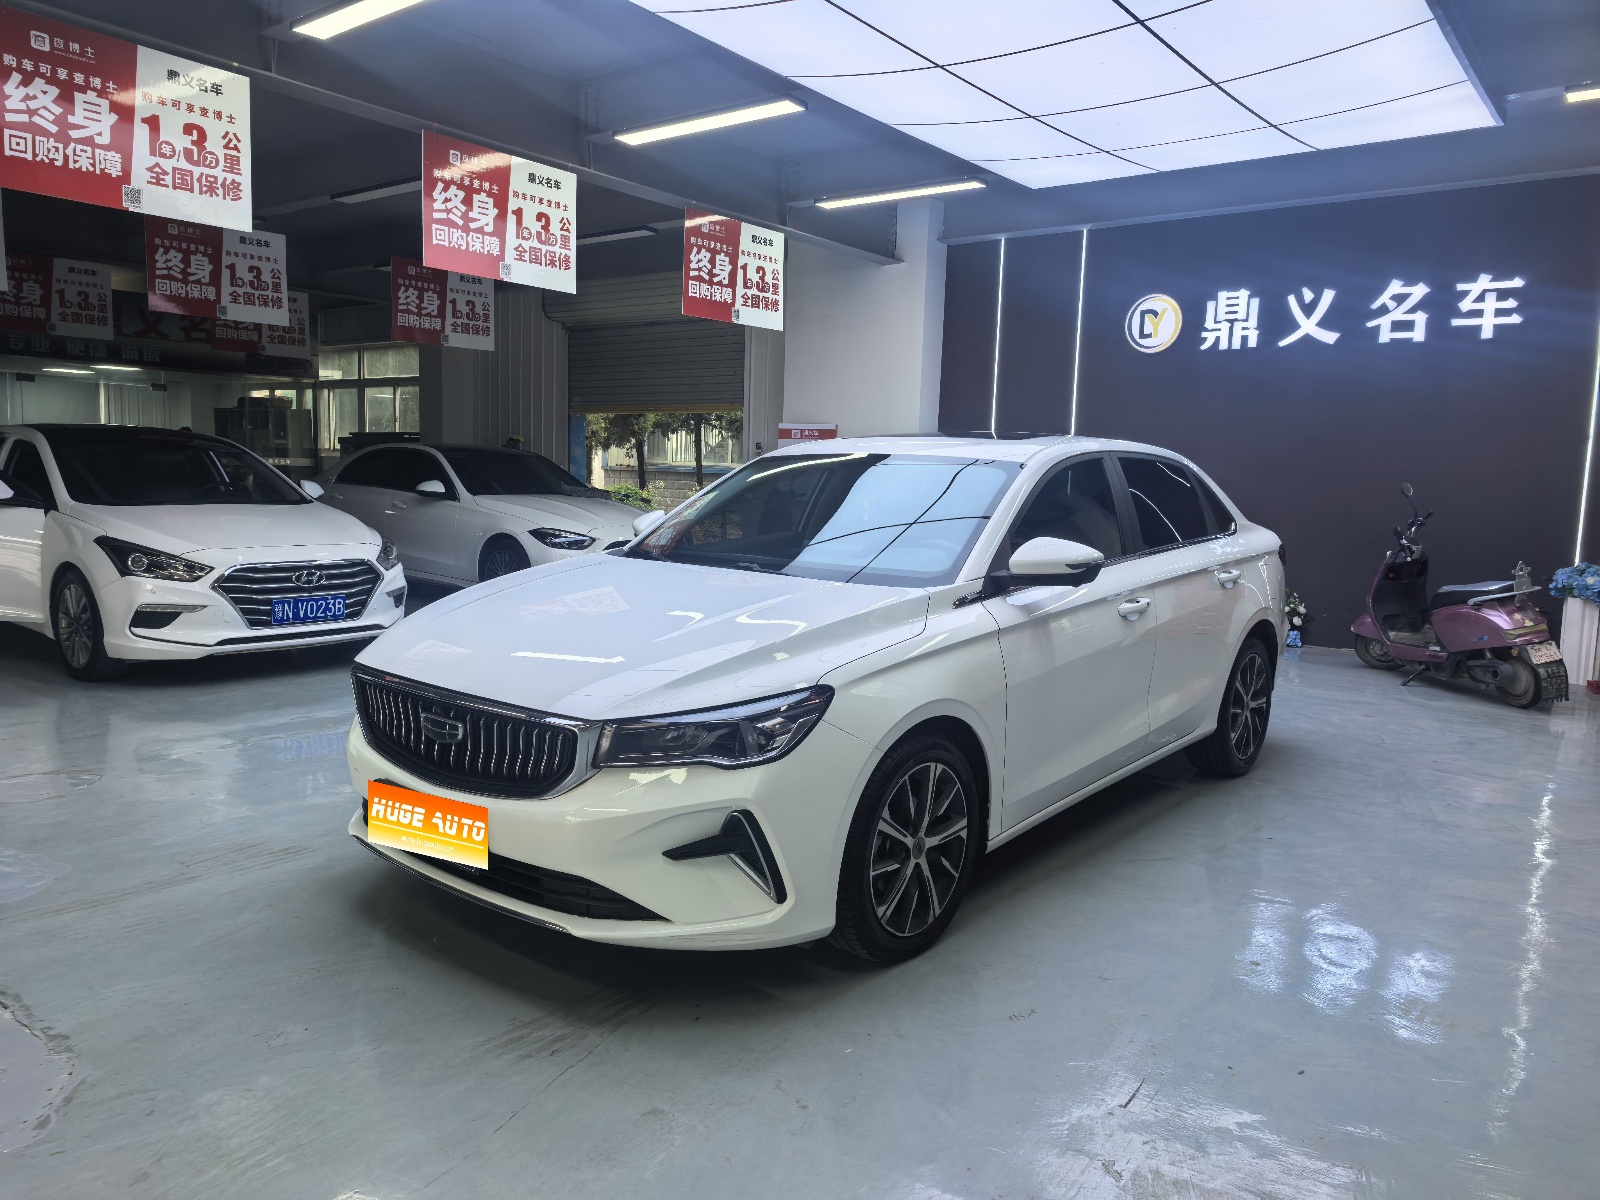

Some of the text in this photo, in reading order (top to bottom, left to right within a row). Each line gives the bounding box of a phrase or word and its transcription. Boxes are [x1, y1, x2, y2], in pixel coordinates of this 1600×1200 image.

[53, 37, 95, 58] 查博士
[2, 53, 118, 94] 购车可享查博士
[166, 68, 224, 96] 鼎义名车
[2, 70, 119, 145] 终身
[141, 90, 236, 124] 购车可享查博士
[4, 128, 122, 177] 回购保障
[145, 162, 243, 202] 全国保修
[528, 172, 562, 191] 鼎义名车
[432, 181, 499, 233] 终身
[513, 190, 569, 212] 购车可享查博士
[432, 223, 500, 257] 回购保障
[154, 246, 214, 284] 终身
[514, 243, 571, 272] 全国保修
[689, 246, 732, 285] 终身
[155, 278, 217, 302] 回购保障
[229, 290, 284, 310] 全国保修
[398, 286, 440, 316] 终身
[688, 280, 733, 304] 回购保障
[741, 291, 780, 313] 全国保修
[58, 311, 109, 327] 全国保修
[397, 313, 442, 331] 回购保障
[1200, 273, 1526, 350] 鼎义名车
[215, 327, 259, 342] 回购保障
[267, 334, 307, 347] 全国保修
[450, 321, 491, 337] 全国保修
[6, 334, 50, 352] 专业
